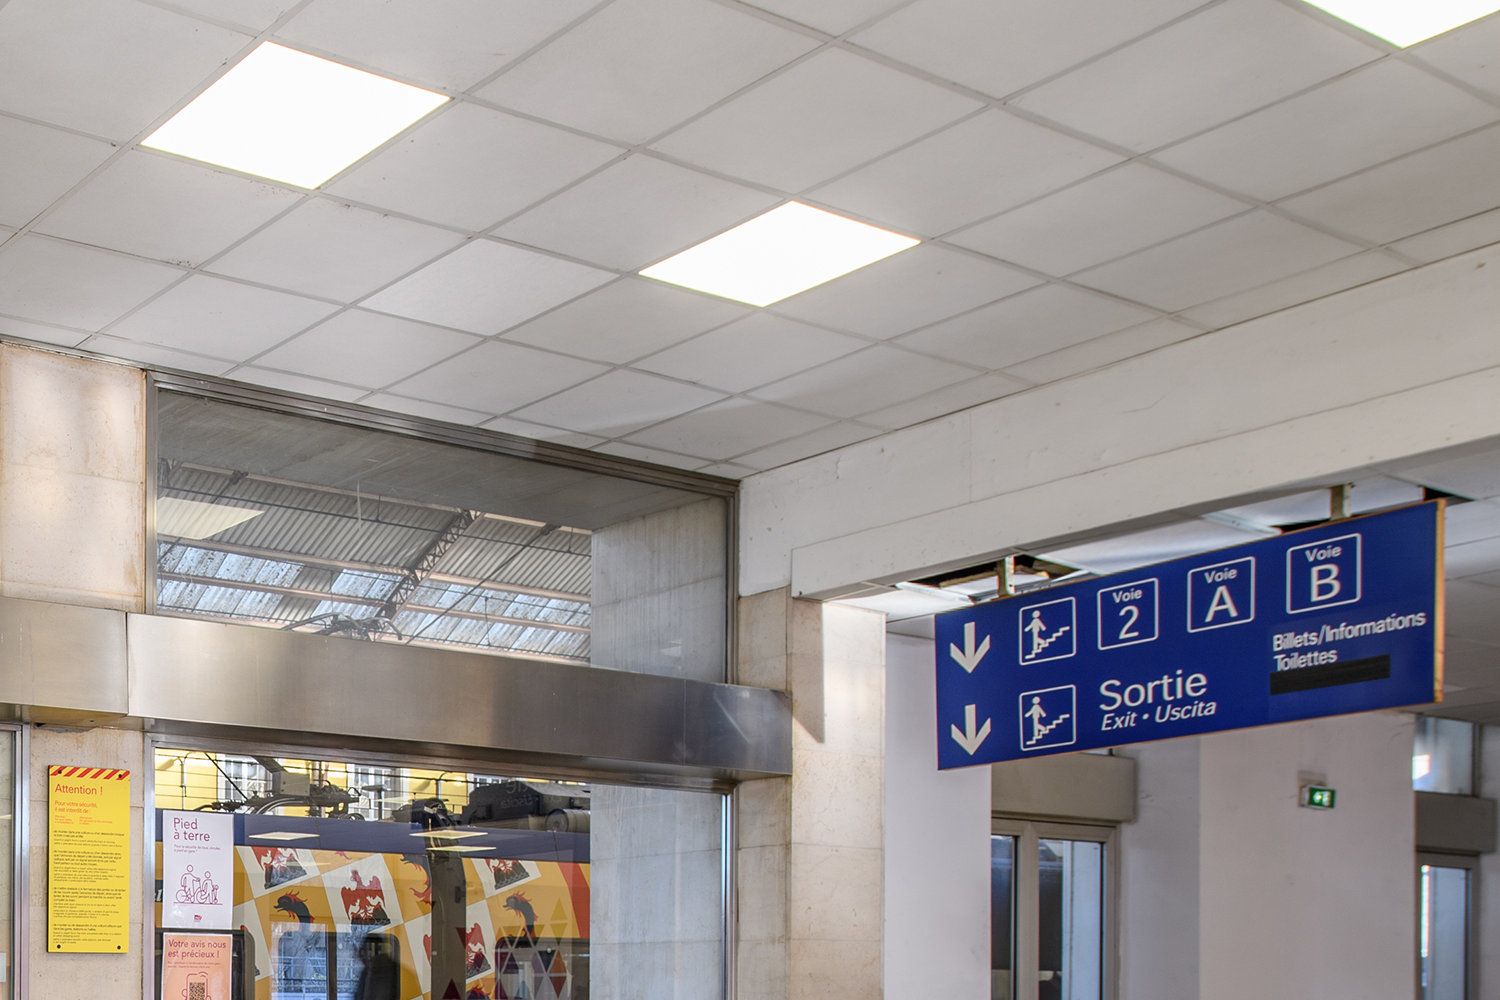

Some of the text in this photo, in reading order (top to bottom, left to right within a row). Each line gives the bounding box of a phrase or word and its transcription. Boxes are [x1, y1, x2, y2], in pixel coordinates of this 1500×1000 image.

[1305, 544, 1341, 562] Voie
[1205, 567, 1237, 584] Voie
[1311, 564, 1341, 603] B
[1113, 588, 1142, 604] Voie
[1205, 585, 1238, 623] A
[1118, 605, 1140, 640] 2
[1273, 611, 1425, 653] Billets/Informations
[1273, 649, 1337, 672] Toilettes
[1100, 669, 1208, 710] Sortie
[1100, 699, 1216, 731] Exit Uscita
[55, 784, 103, 795] Attention !
[174, 818, 198, 830] Pied
[174, 829, 210, 841] à terre
[169, 939, 188, 948] Votre
[182, 951, 215, 959] précieux
